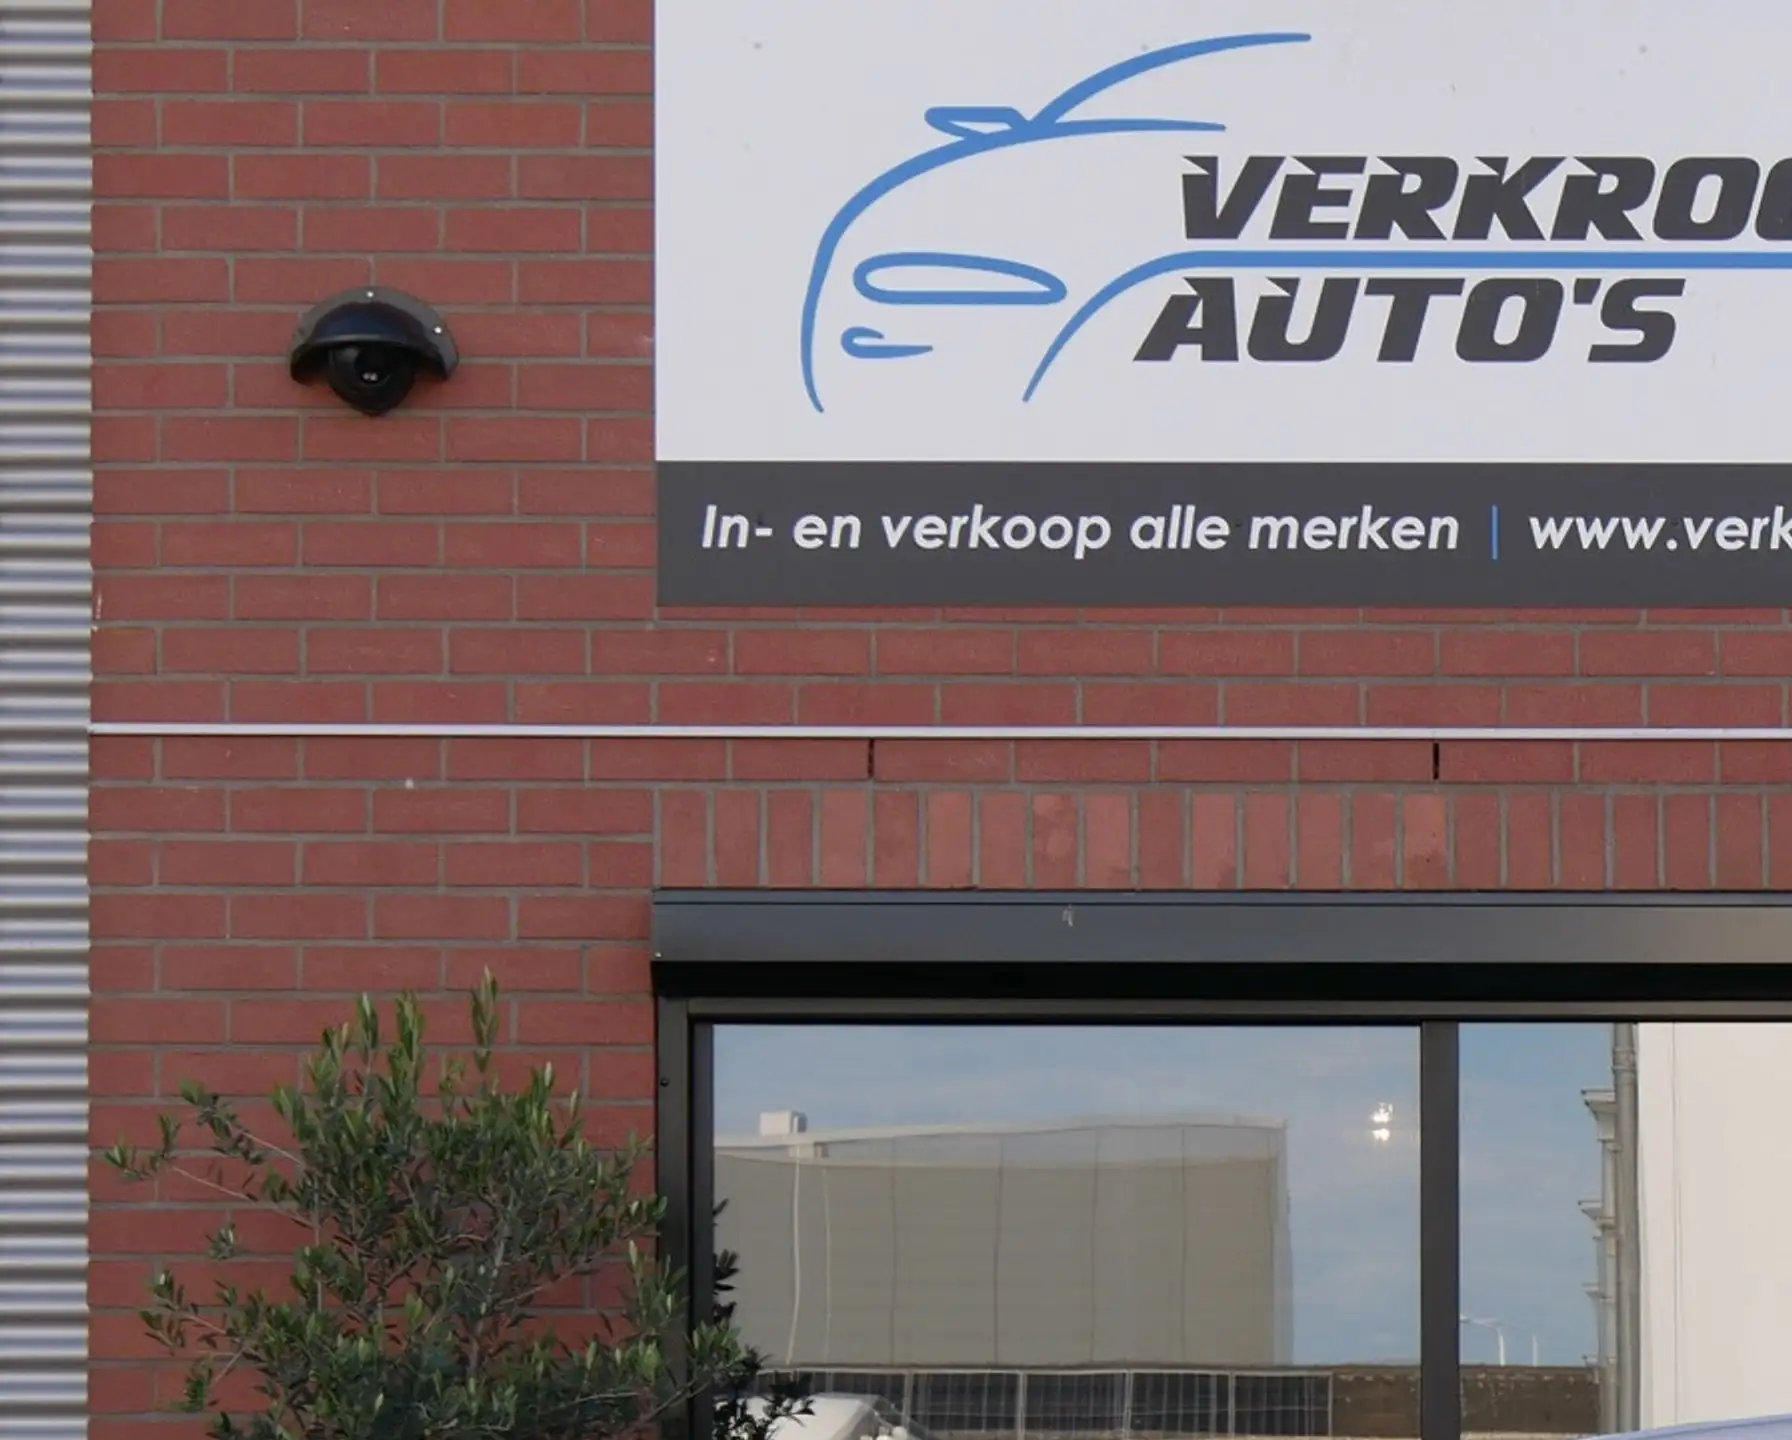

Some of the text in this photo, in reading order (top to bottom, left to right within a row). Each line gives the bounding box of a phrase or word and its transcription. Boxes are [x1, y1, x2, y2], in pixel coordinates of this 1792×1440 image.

[1132, 275, 1687, 363] AUTO'S
[701, 504, 1460, 560] In- en verkoop alle merken
